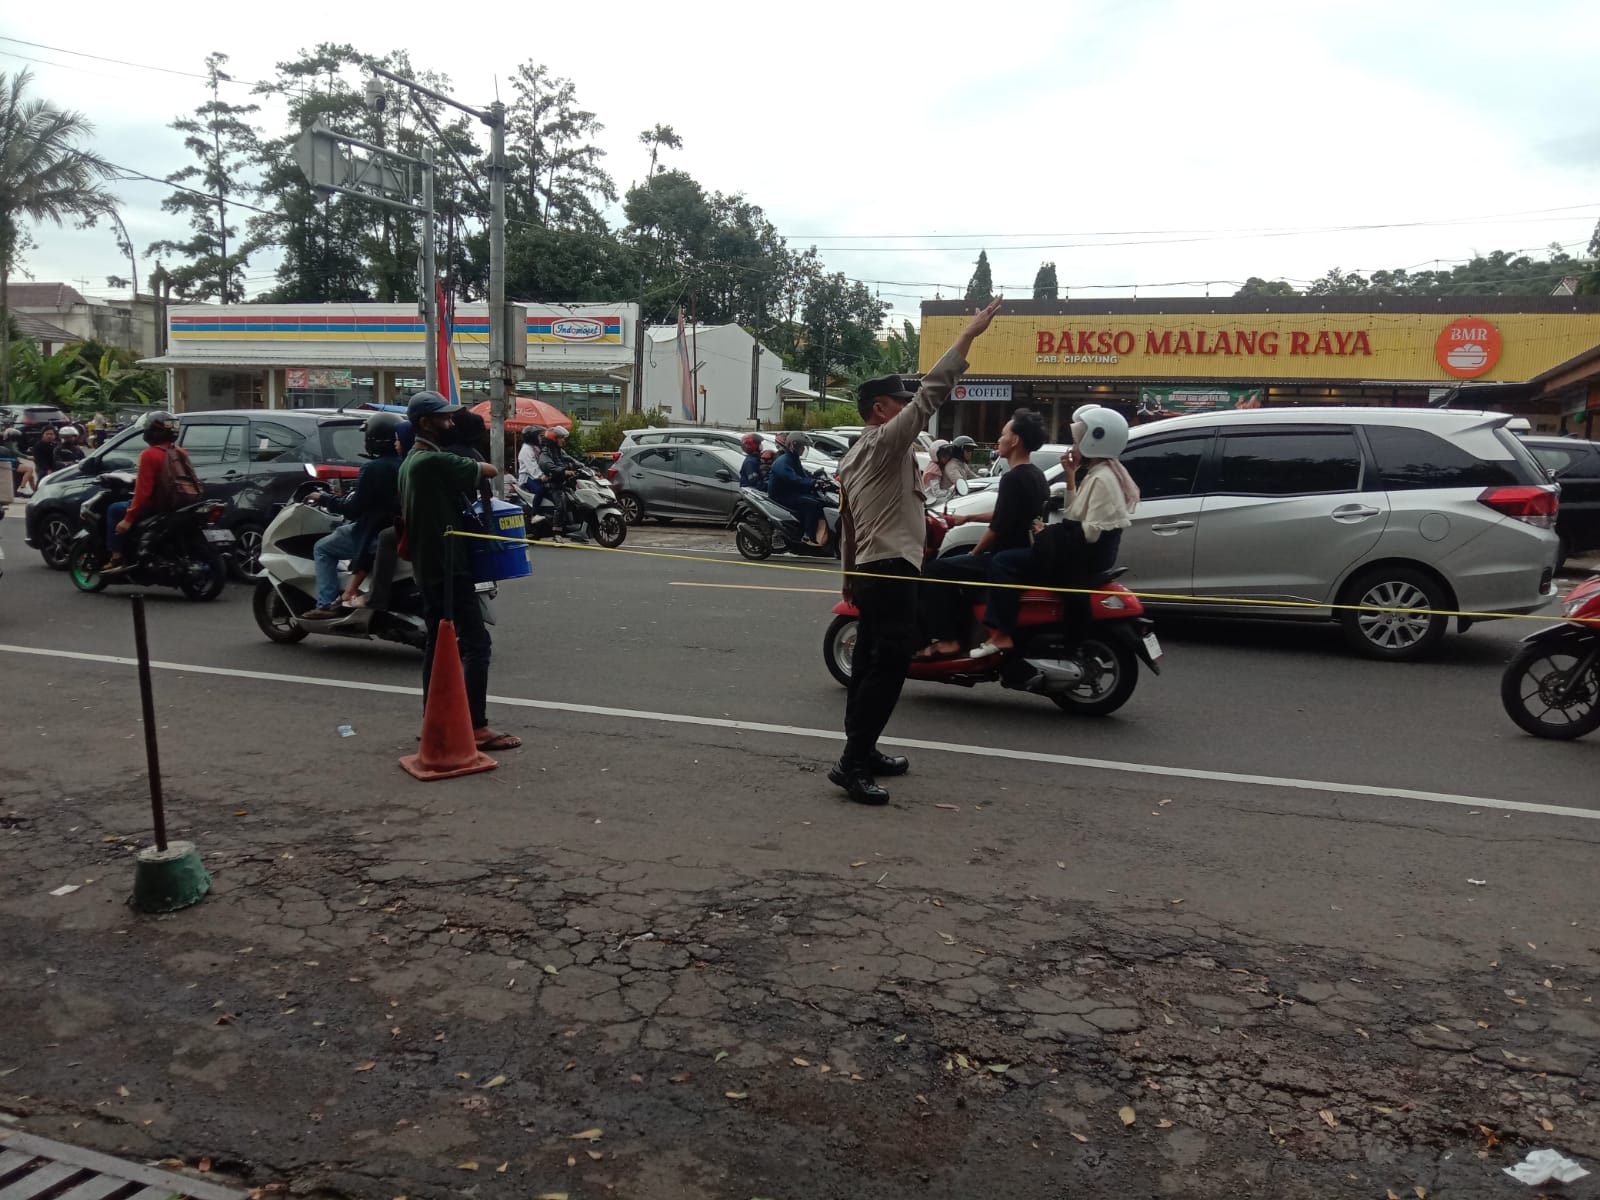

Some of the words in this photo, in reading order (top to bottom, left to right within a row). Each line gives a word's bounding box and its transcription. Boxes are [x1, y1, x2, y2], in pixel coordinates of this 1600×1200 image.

[1451, 328, 1488, 341] BMR
[1036, 330, 1135, 355] BAKSO
[1144, 330, 1279, 356] MALANG
[1290, 330, 1373, 356] RAYA
[1036, 355, 1060, 364] CAB.
[1063, 355, 1119, 364] CIPAYUNG
[968, 387, 1009, 398] COFFEE
